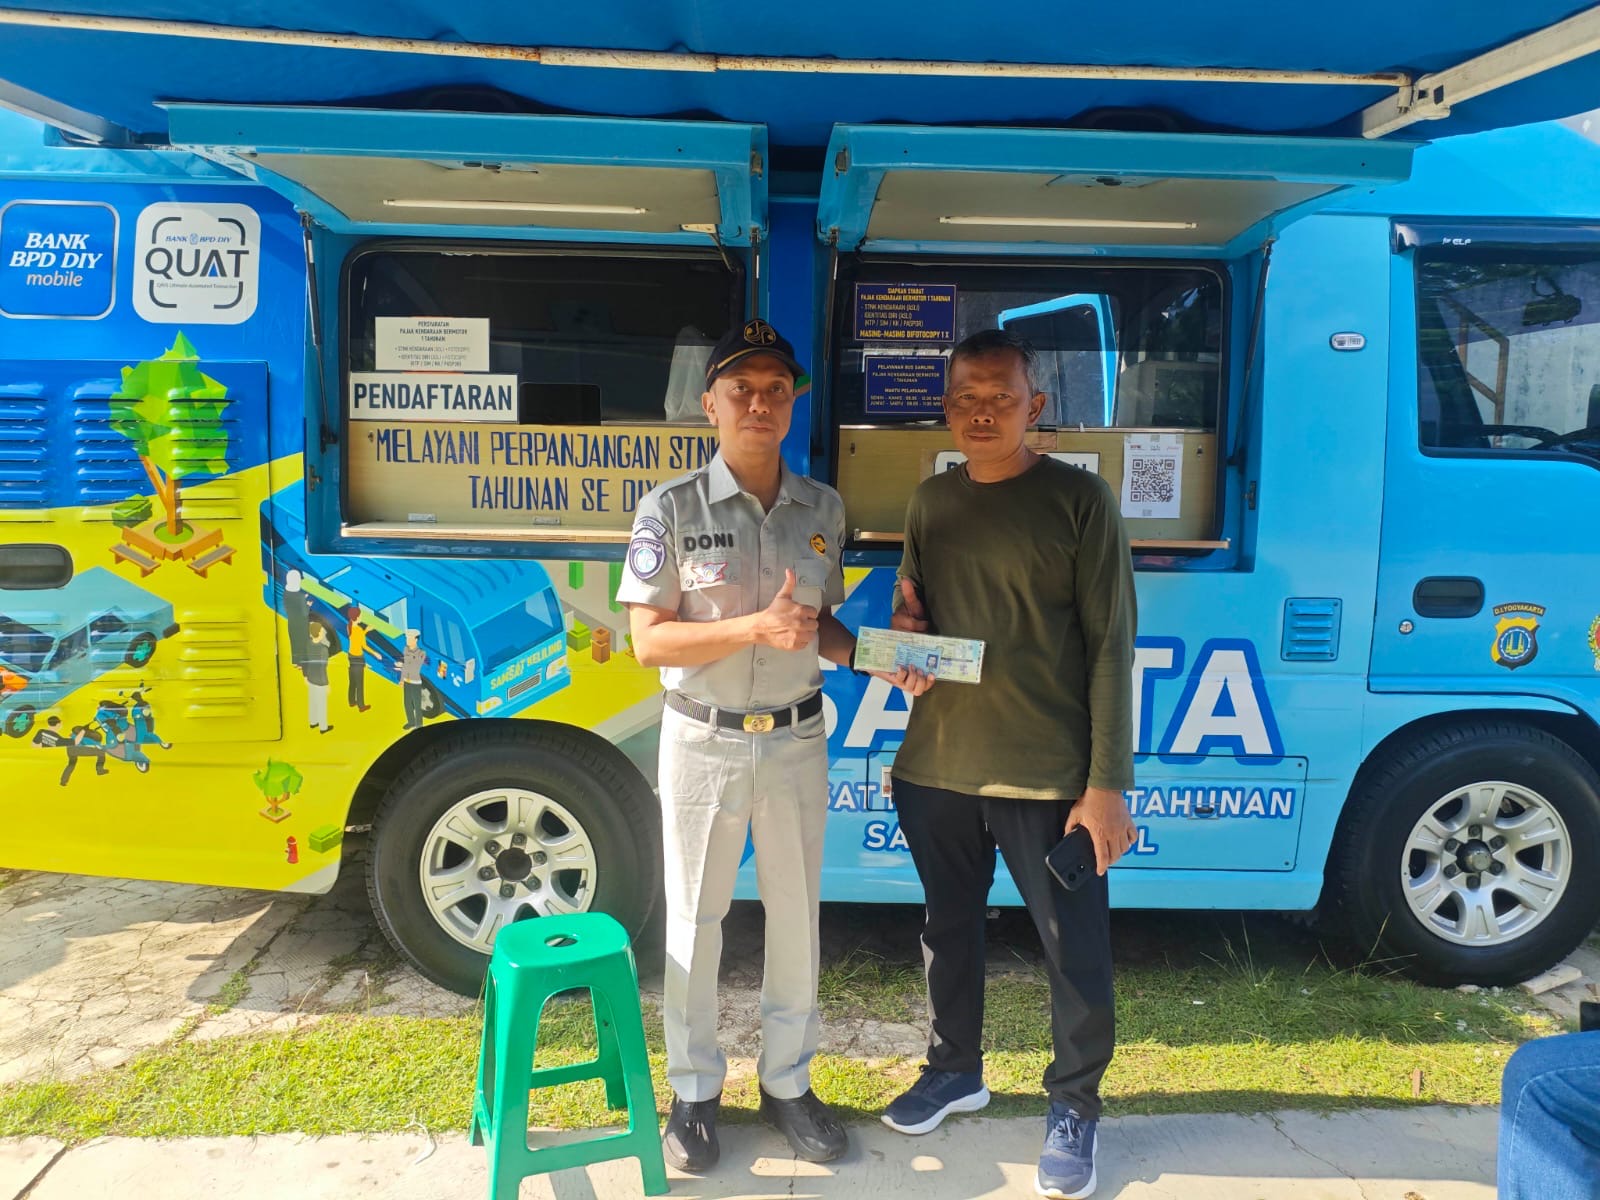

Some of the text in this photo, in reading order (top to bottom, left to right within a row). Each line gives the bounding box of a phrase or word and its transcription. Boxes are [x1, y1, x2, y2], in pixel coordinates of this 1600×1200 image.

[25, 232, 90, 250] BANK
[9, 251, 103, 269] BPD DIY
[145, 247, 250, 280] QUAT
[26, 270, 83, 287] mobile
[353, 383, 512, 411] PENDAFTARAN
[376, 428, 480, 465] MELAYANI
[491, 431, 660, 470] PERPANJANGAN
[468, 475, 569, 511] TAHUNAN
[581, 478, 610, 512] SE
[684, 532, 734, 552] DONI
[1125, 790, 1292, 816] TAHUNAN
